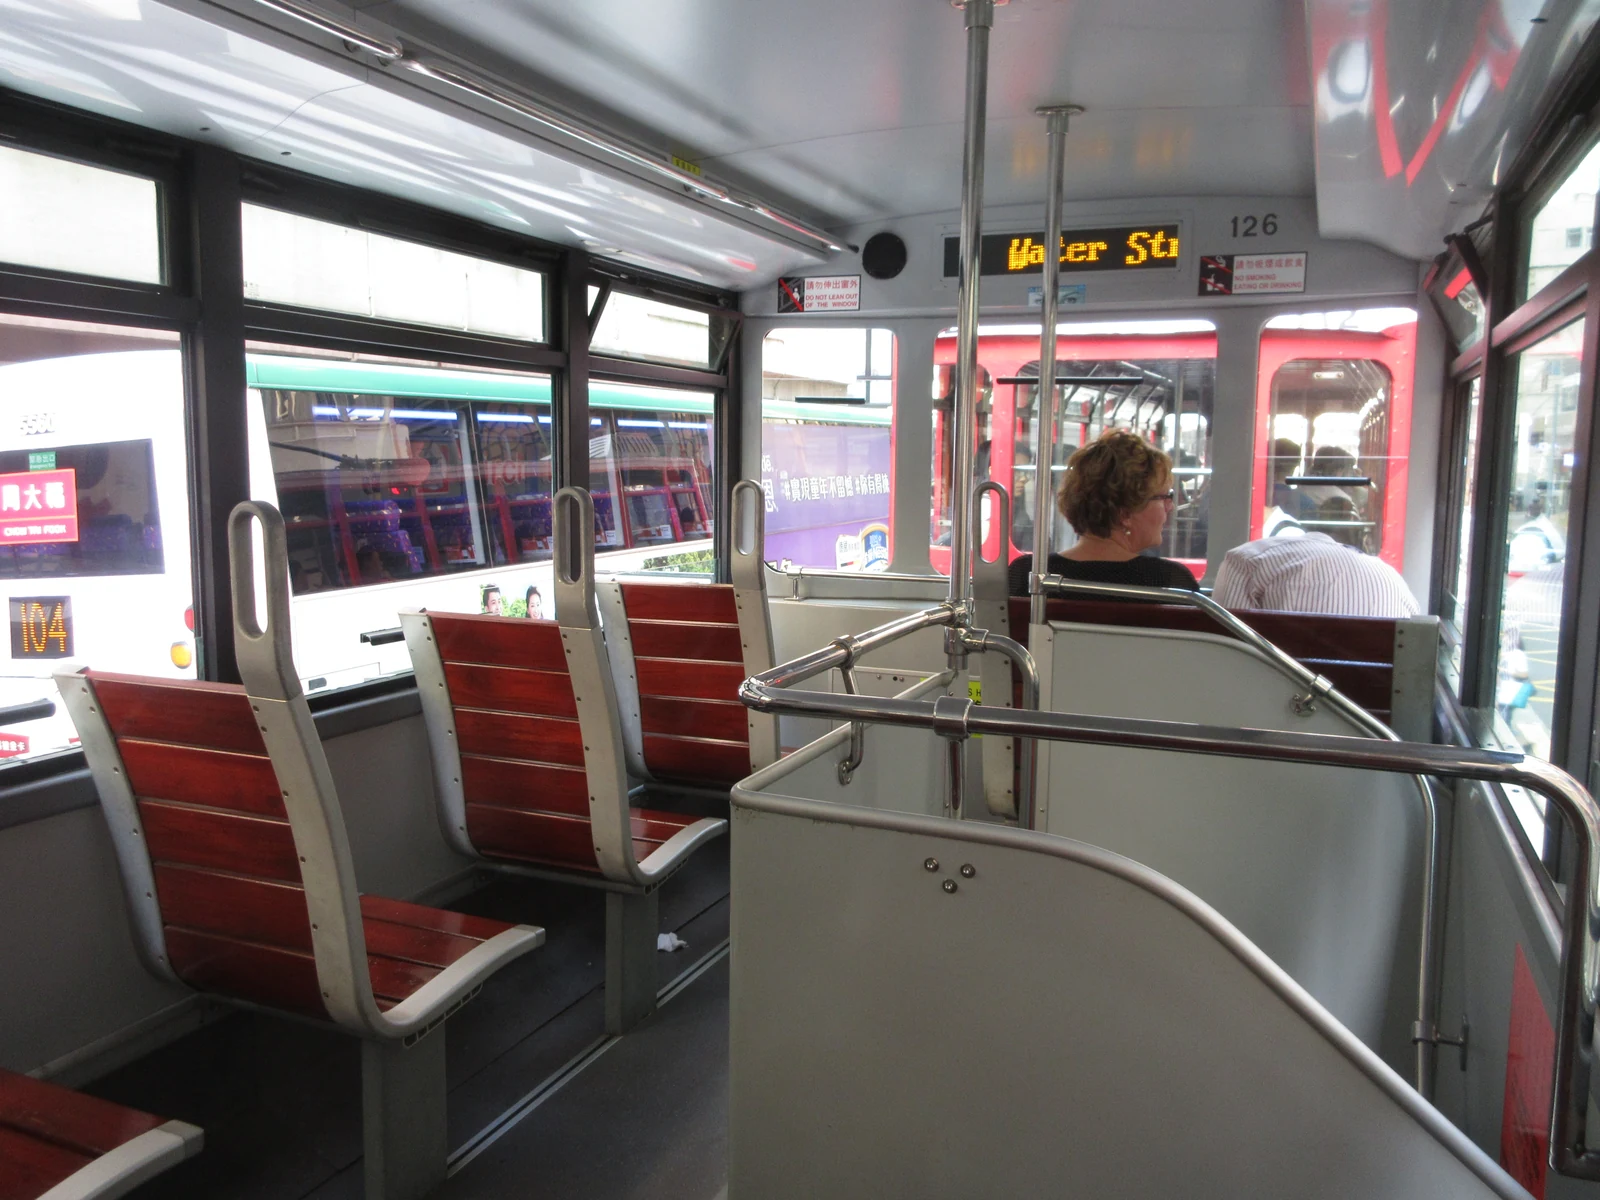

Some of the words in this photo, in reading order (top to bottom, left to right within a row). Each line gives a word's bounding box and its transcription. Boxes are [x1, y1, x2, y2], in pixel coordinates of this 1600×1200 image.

[1231, 213, 1278, 238] 126
[1008, 236, 1107, 270] Waer
[20, 602, 67, 652] 104
